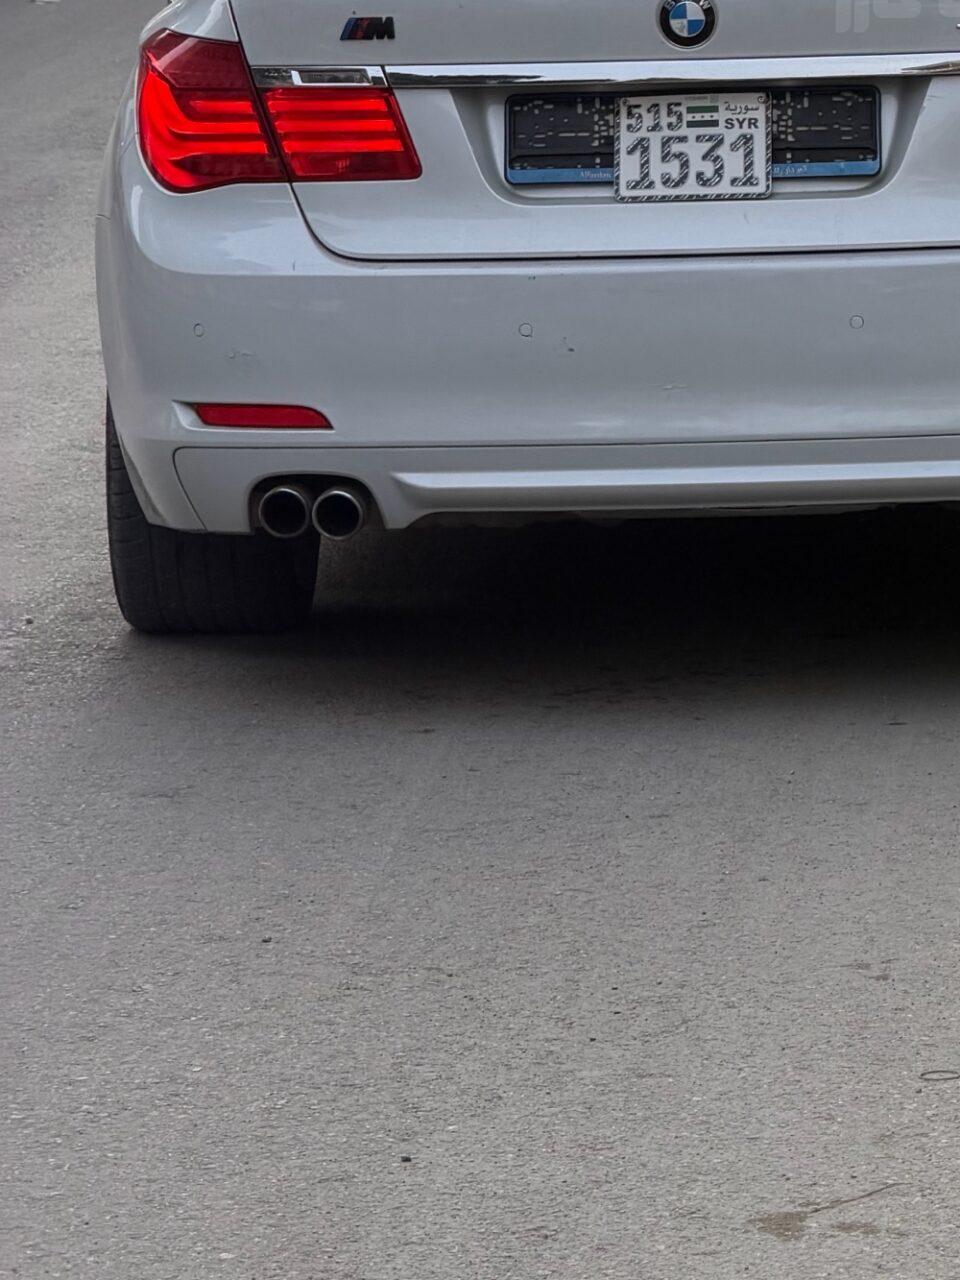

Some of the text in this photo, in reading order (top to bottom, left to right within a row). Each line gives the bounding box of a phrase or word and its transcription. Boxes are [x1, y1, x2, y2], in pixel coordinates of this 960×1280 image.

[626, 102, 683, 133] 515
[724, 101, 760, 115] سورية
[724, 117, 760, 130] SYR
[626, 134, 760, 190] 1531
